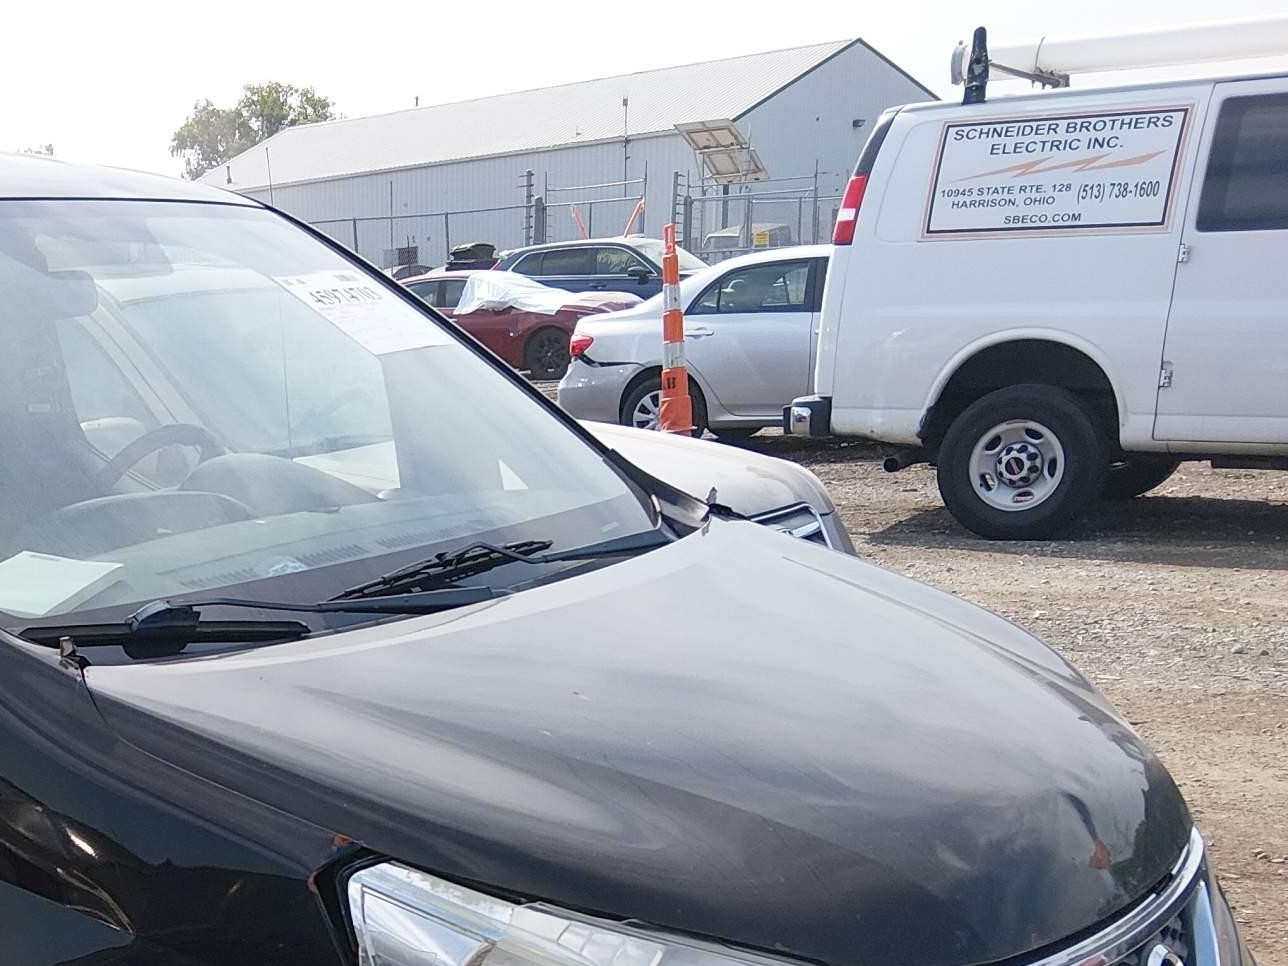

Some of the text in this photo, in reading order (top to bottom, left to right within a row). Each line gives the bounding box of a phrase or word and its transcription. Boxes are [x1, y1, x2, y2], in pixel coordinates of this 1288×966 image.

[953, 115, 1174, 141] SCHNEIDER BROTHERS
[989, 136, 1124, 156] ELECTRIC INC.
[941, 183, 1072, 198] 10945 STATE RTE. 128
[1077, 181, 1160, 206] (513) 738-1600
[951, 196, 1056, 209] HARRISON, OHIO
[1003, 213, 1082, 225] SBECO.COM
